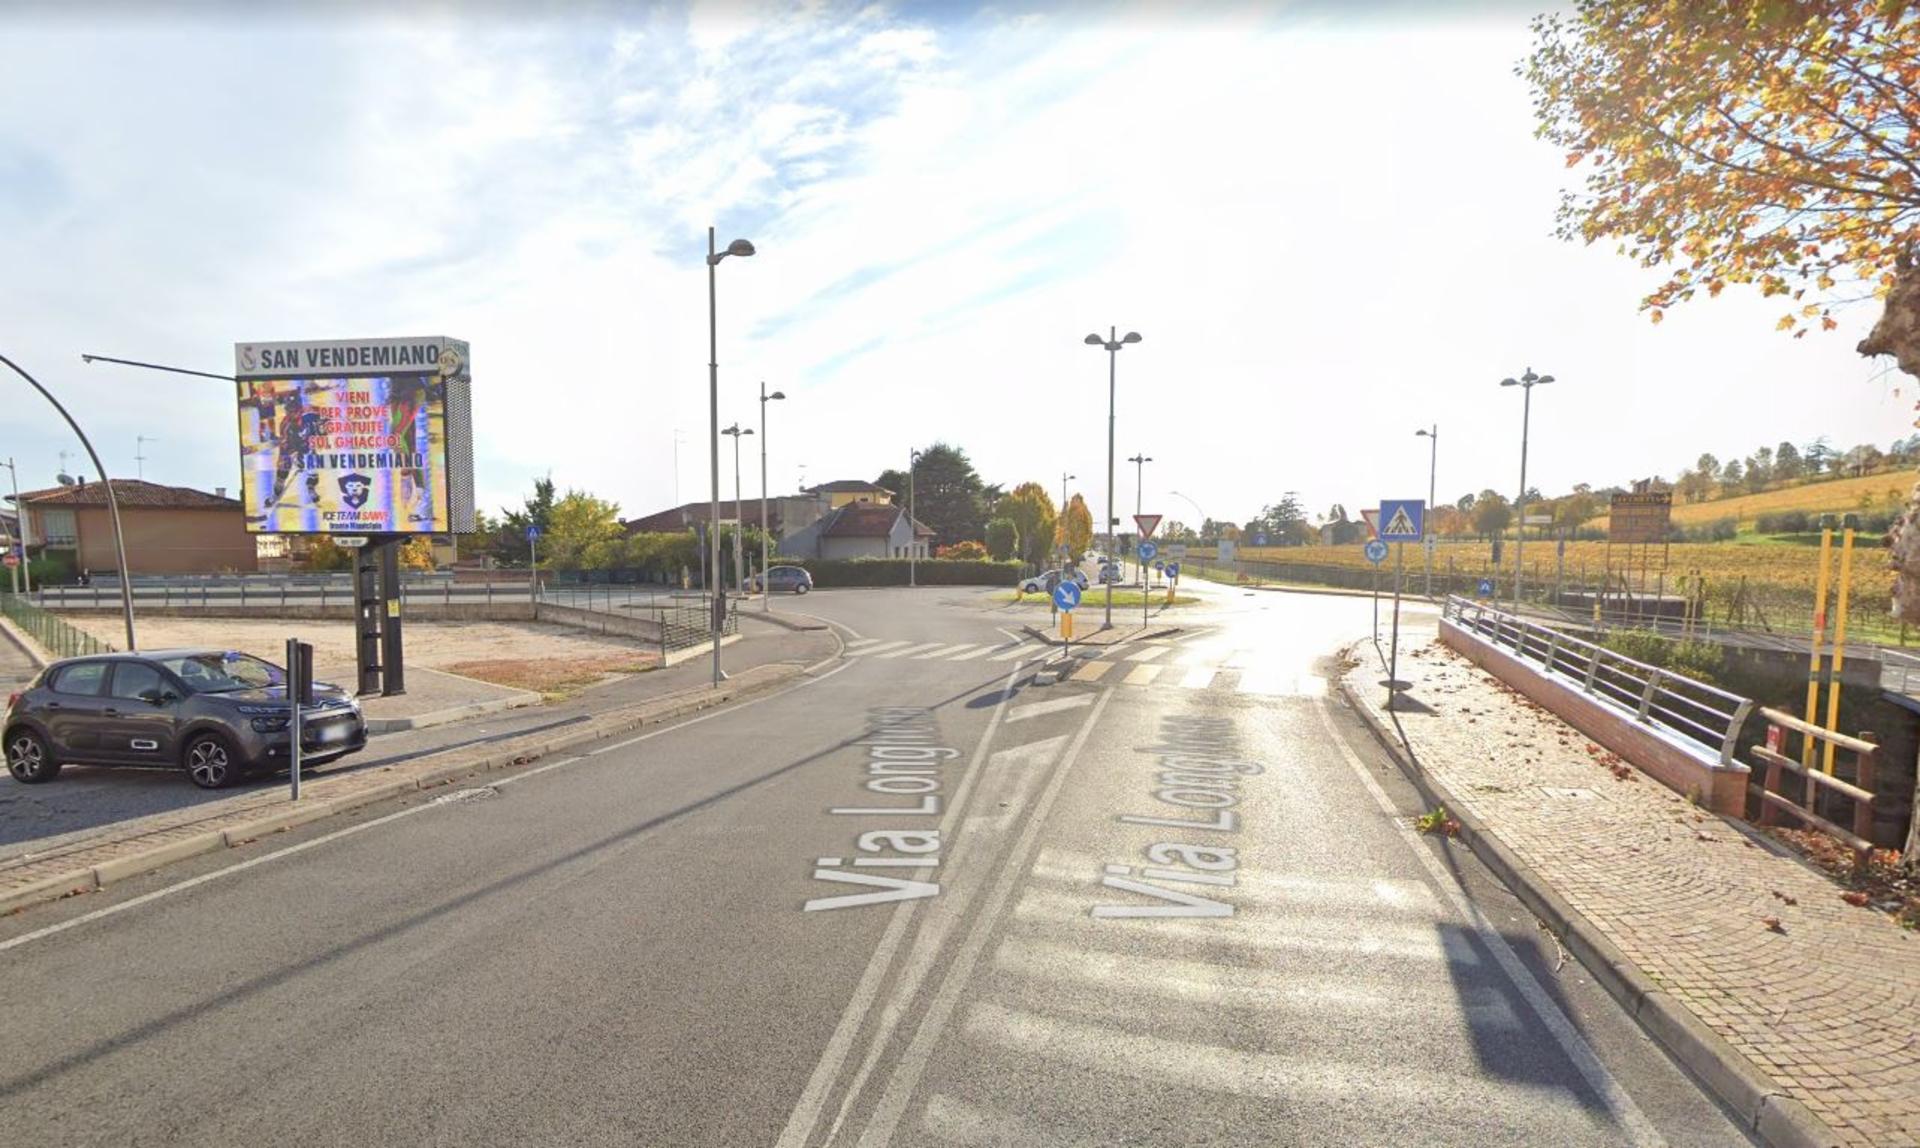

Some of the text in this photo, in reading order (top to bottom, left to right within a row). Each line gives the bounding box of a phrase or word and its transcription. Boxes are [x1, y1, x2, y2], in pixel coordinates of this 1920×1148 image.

[261, 348, 299, 369] SAN
[306, 344, 440, 368] VENDEMIANO
[336, 391, 370, 403] VIENI
[320, 406, 388, 418] PER PROVE
[327, 421, 384, 433] GRATUITE
[310, 436, 332, 449] SUL
[298, 454, 325, 469] SAN
[330, 453, 423, 468] VENDEMIANO
[337, 511, 361, 520] TEAM
